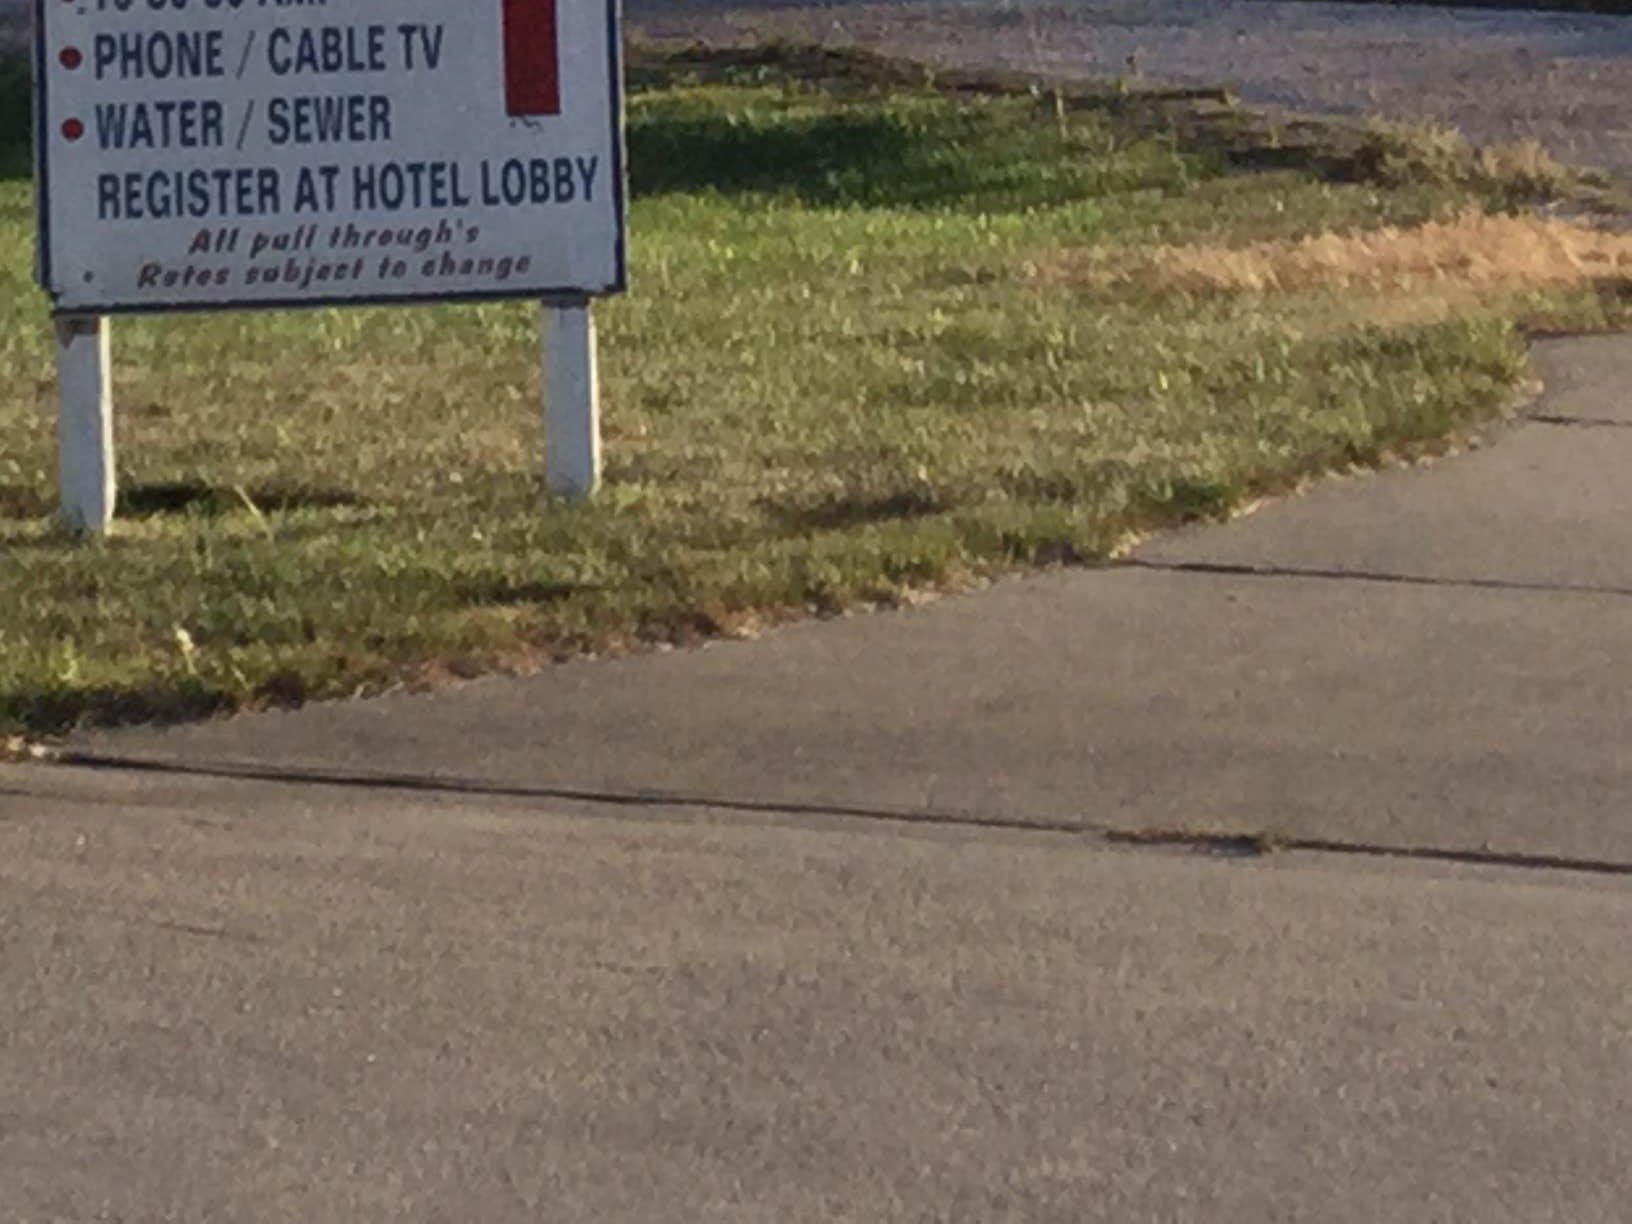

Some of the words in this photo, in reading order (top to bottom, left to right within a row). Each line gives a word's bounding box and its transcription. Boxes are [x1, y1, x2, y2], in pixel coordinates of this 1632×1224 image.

[94, 29, 225, 81] PHONE
[268, 25, 386, 77] CABLE
[397, 23, 445, 70] TV
[95, 99, 225, 150] WATER
[268, 95, 392, 145] SEWER
[98, 169, 280, 220] REGISTER
[293, 165, 340, 213] AT
[352, 161, 469, 210] HOTEL
[480, 155, 599, 205] LOBBY
[188, 227, 239, 255] All
[250, 223, 317, 259] pull
[328, 219, 481, 252] through's
[244, 256, 365, 289] subject
[378, 256, 407, 278] to
[421, 252, 532, 280] change
